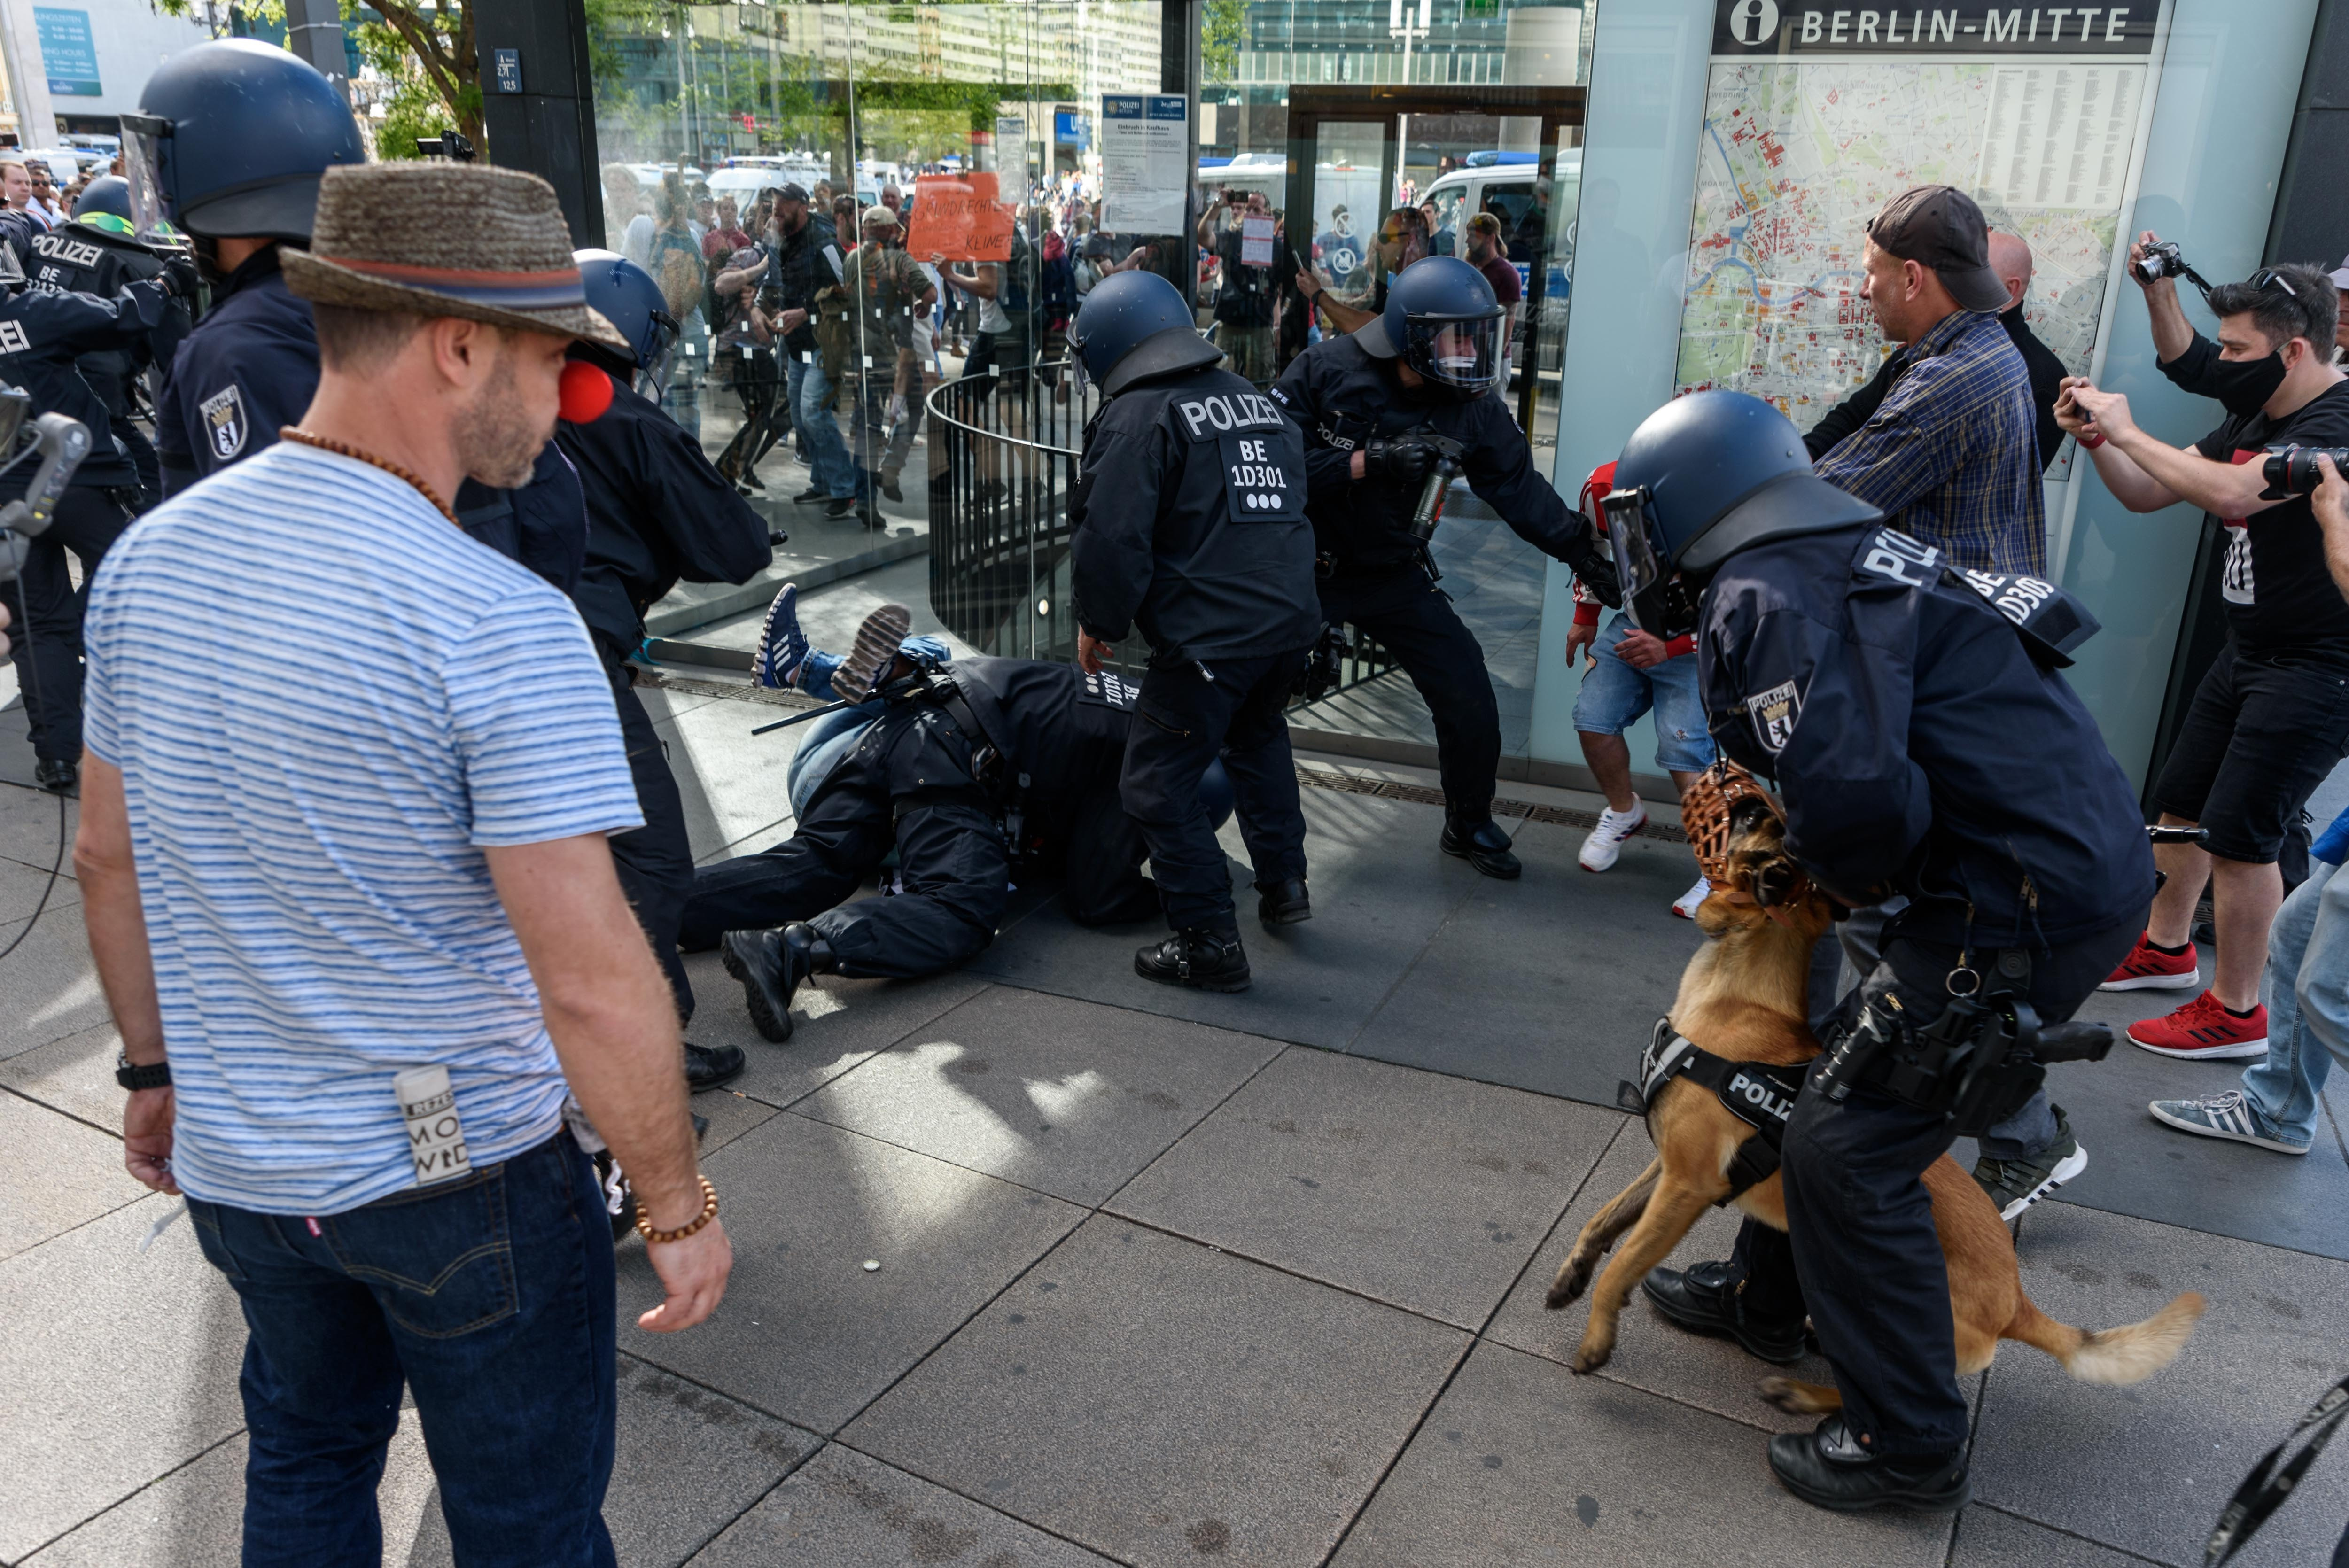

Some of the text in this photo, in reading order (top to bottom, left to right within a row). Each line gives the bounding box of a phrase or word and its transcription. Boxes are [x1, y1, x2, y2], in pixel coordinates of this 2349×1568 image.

[1801, 8, 2130, 43] BERLIN-MITTE
[31, 235, 104, 267] POLIZEI
[39, 265, 61, 282] BE
[0, 319, 31, 356] EI
[1271, 388, 1290, 404] BFE
[1180, 394, 1284, 435] POLIZEI
[1239, 440, 1268, 462] BE
[1231, 465, 1287, 489] 1D301
[1100, 671, 1123, 706] 24101
[1123, 683, 1140, 700] BE
[1750, 683, 1794, 713] POLIZEI
